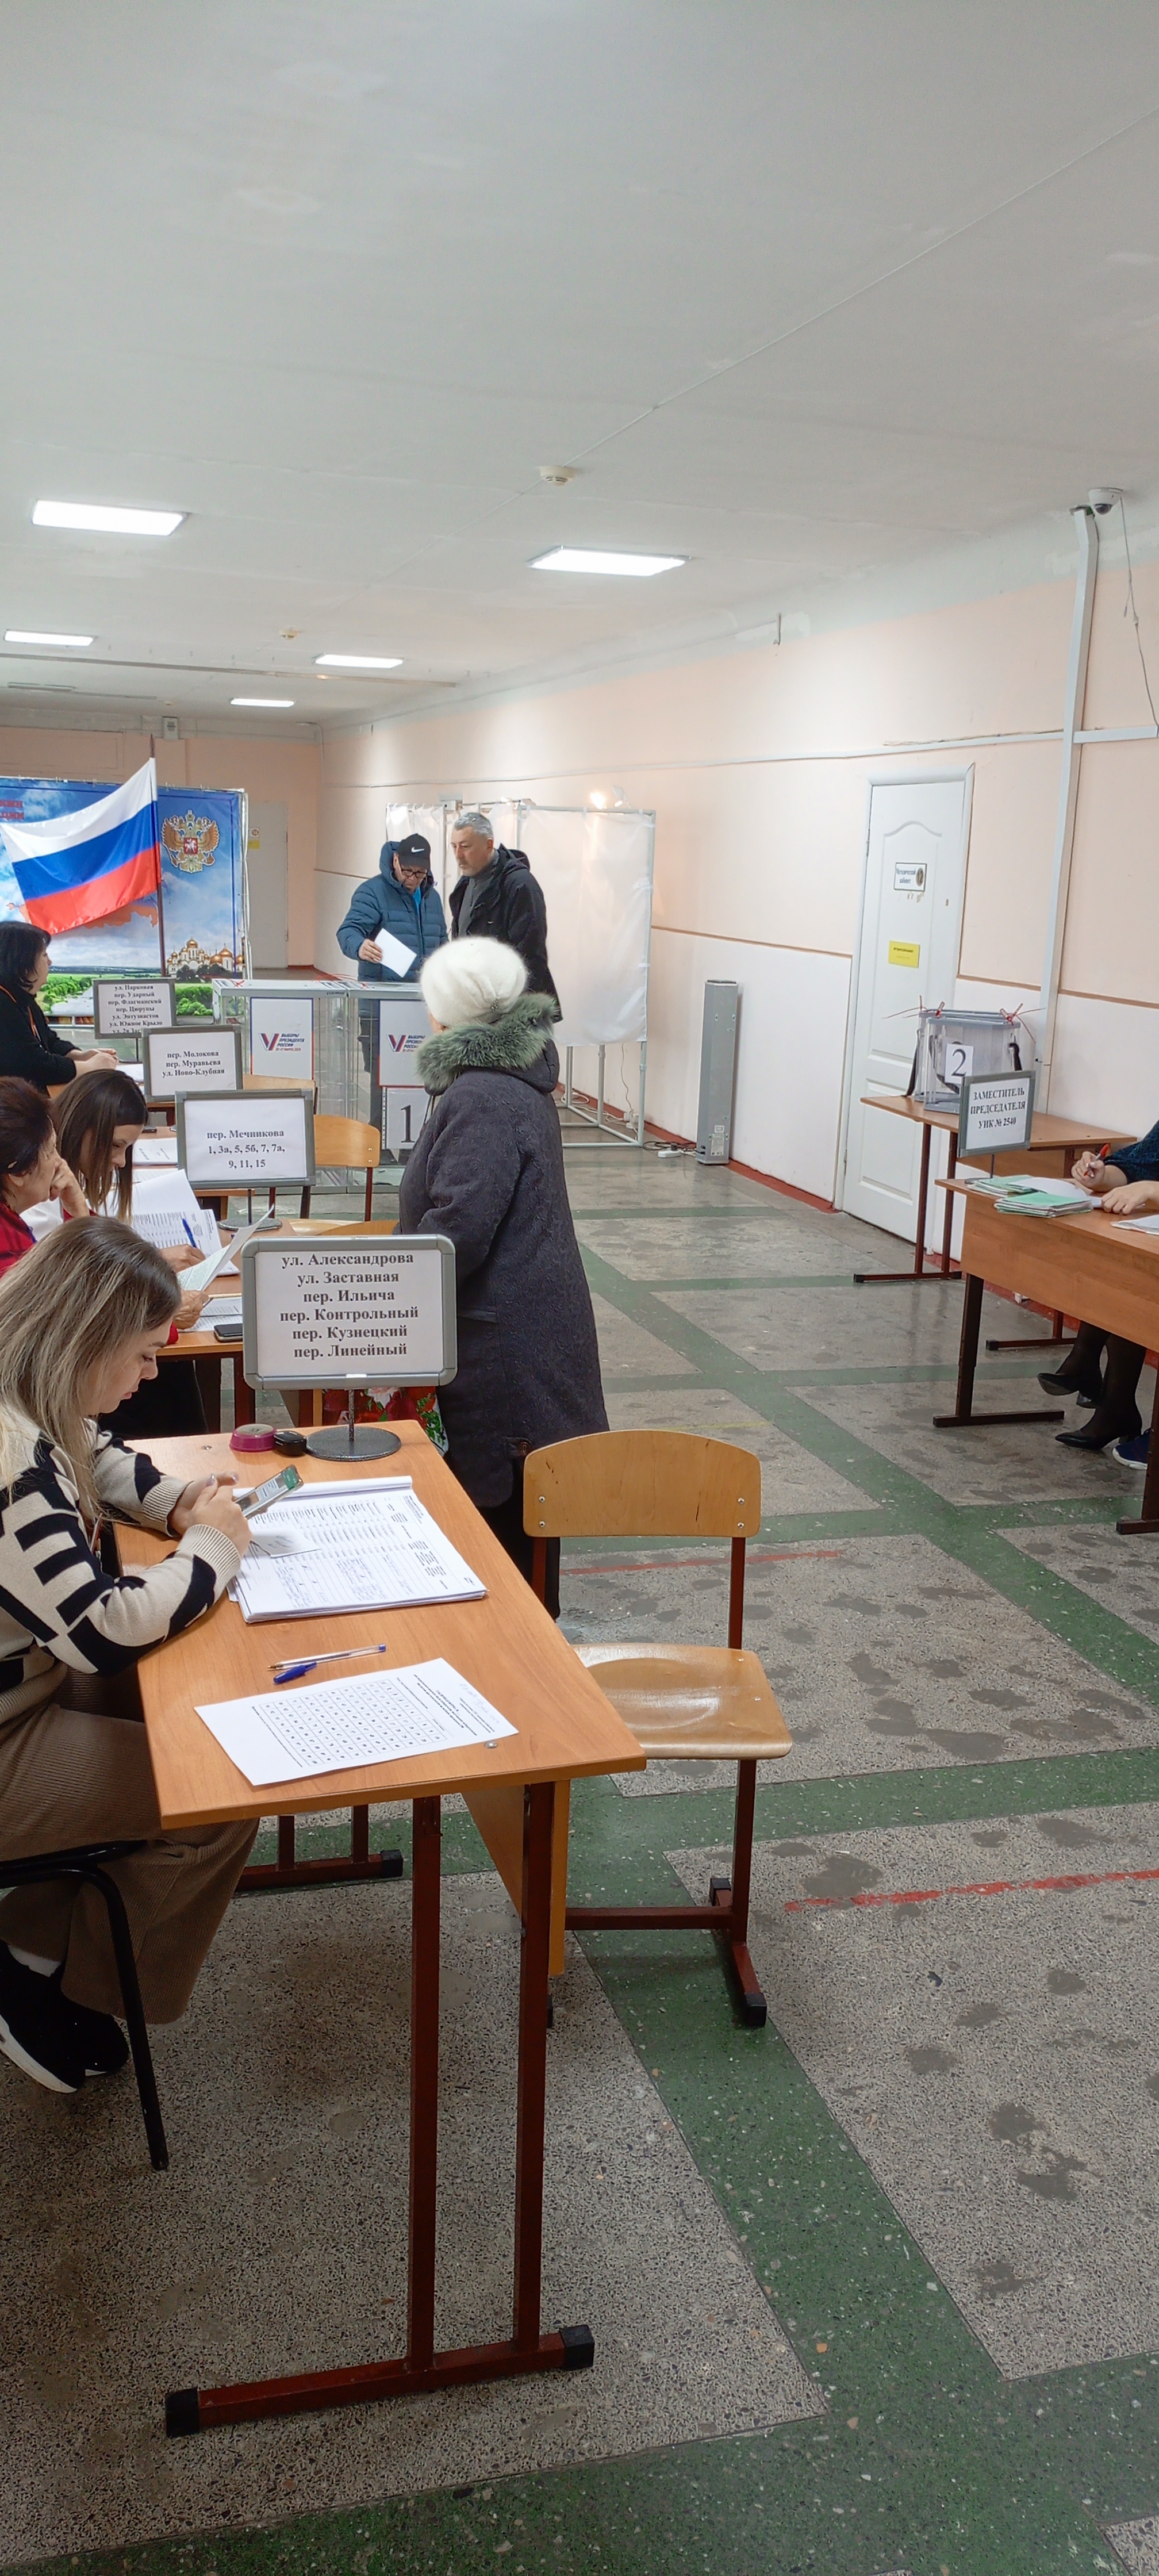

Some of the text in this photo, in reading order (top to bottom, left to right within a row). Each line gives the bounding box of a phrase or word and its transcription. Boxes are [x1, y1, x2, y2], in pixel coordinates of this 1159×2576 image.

[951, 1049, 966, 1076] 2
[175, 1068, 225, 1077] Ново-Клубная
[973, 1087, 1024, 1101] ЗАМЕСТИТЕЛЬ
[970, 1101, 1026, 1114] ПРЕДСЕДАТЕЛЯ
[401, 1105, 415, 1143] 1
[978, 1120, 994, 1129] УИК
[1003, 1117, 1016, 1126] 2540
[207, 1130, 284, 1140] пер. Мечникова
[209, 1144, 285, 1155] 1, 3а, 5, 5б, 7, 7а,
[228, 1159, 266, 1170] 9, 11, 15
[281, 1254, 414, 1268] ул. Александрова
[297, 1271, 399, 1287] ул. Заставная
[304, 1289, 395, 1305] пер. Ильича
[280, 1306, 419, 1324] пер. Контрольный
[293, 1325, 408, 1341] пер. Кузнецкий
[294, 1344, 407, 1360] пер. Линейный
